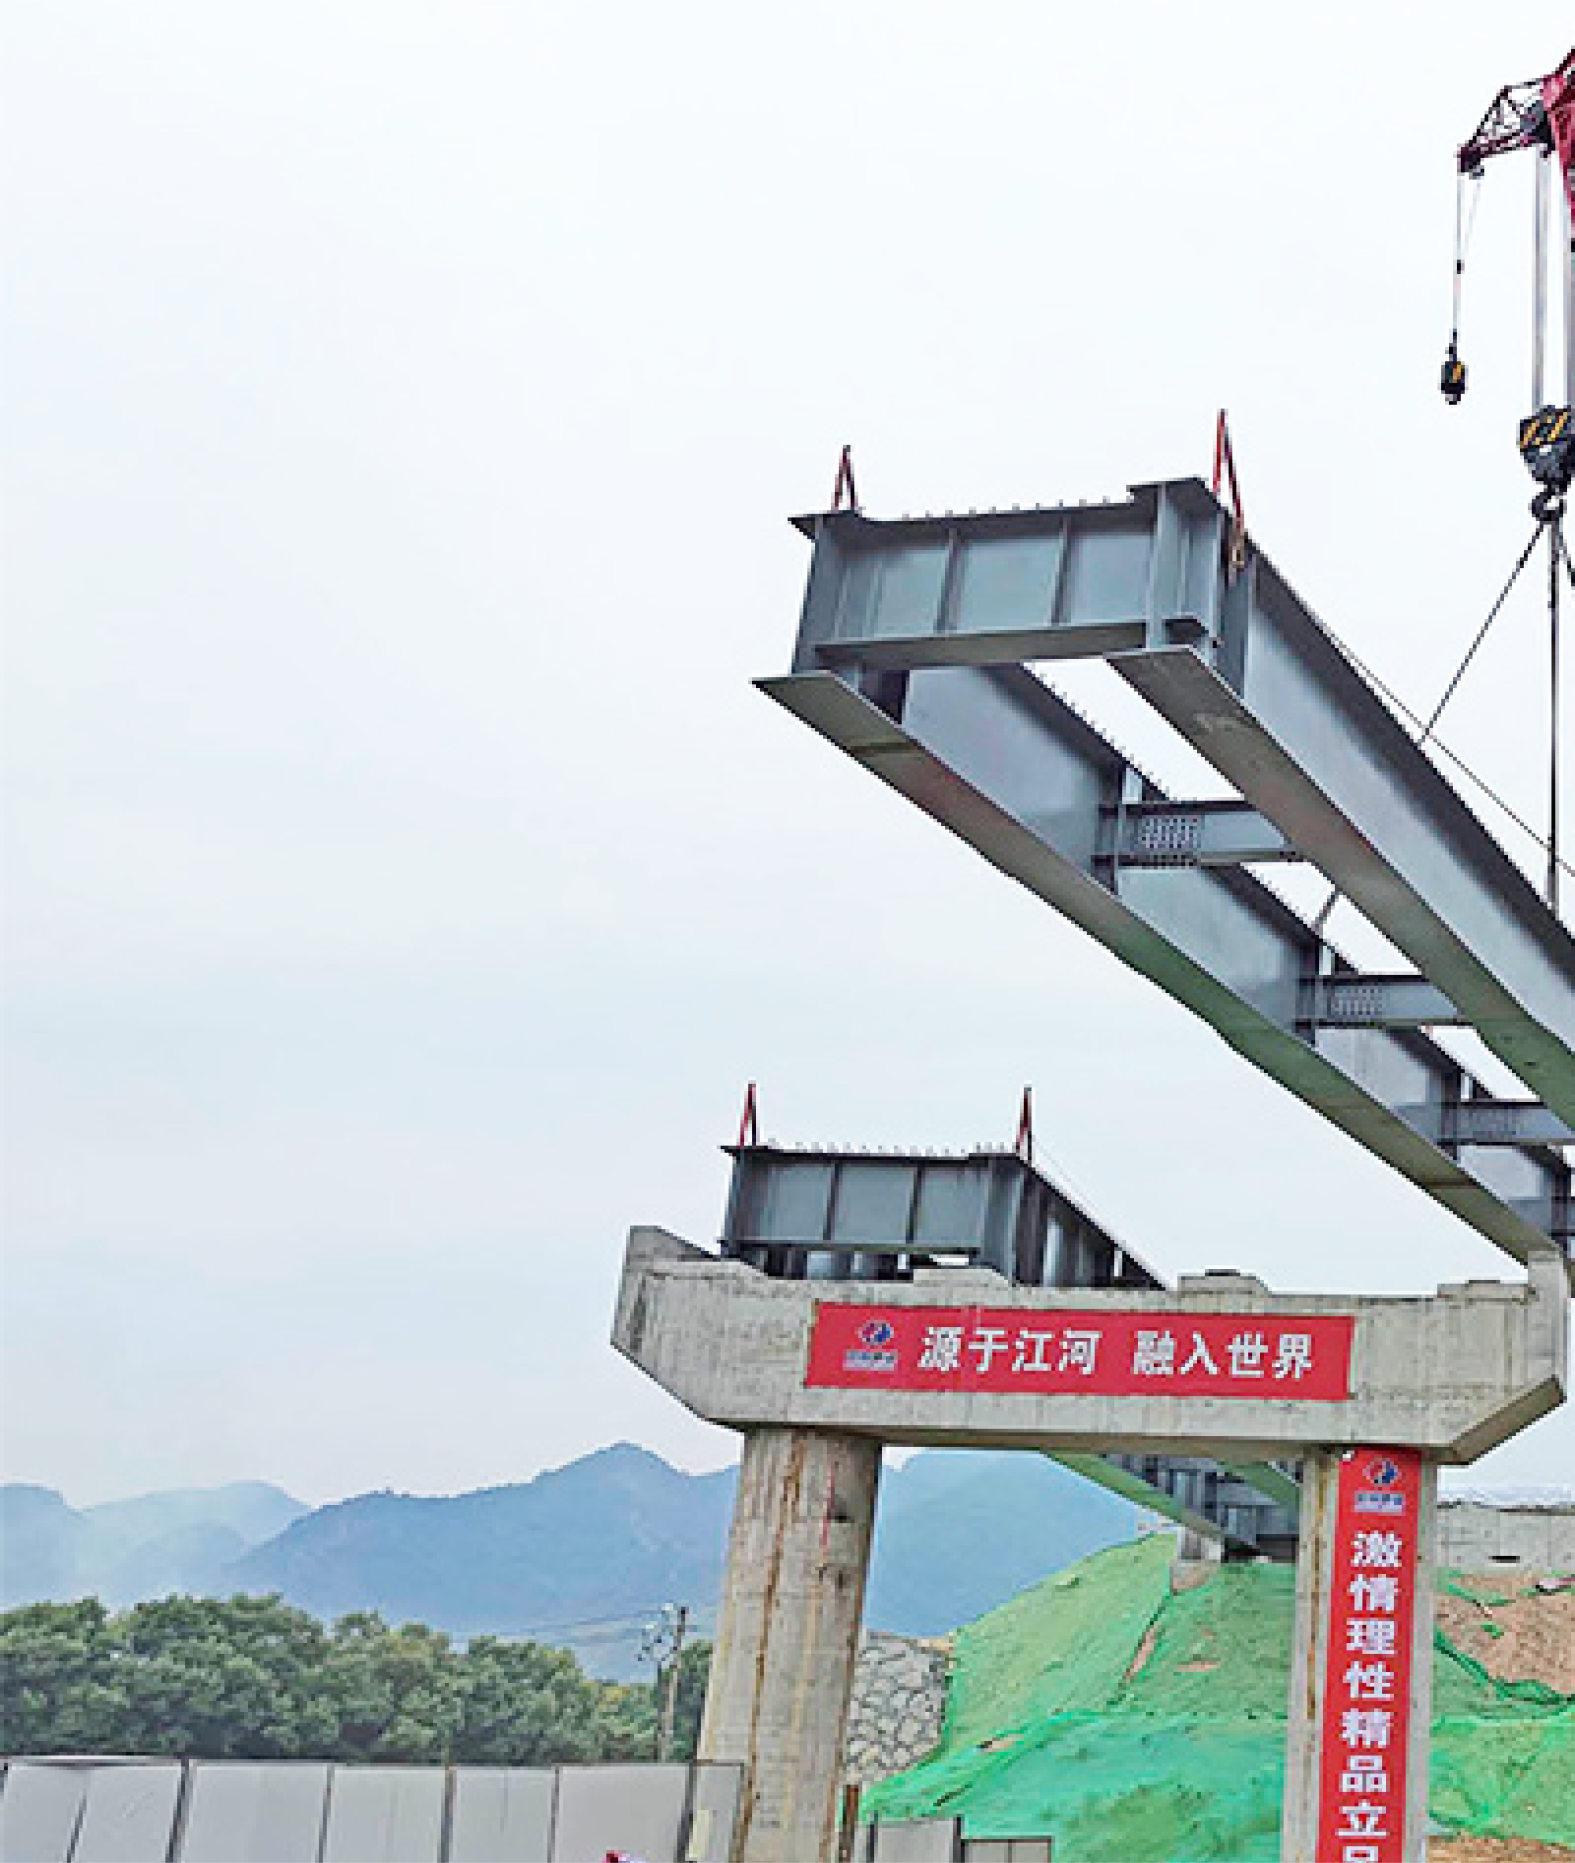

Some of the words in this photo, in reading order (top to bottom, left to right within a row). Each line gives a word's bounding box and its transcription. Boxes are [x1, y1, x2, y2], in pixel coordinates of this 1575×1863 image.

[917, 1326, 1102, 1375] 源于江河
[1133, 1330, 1312, 1382] 融入世界
